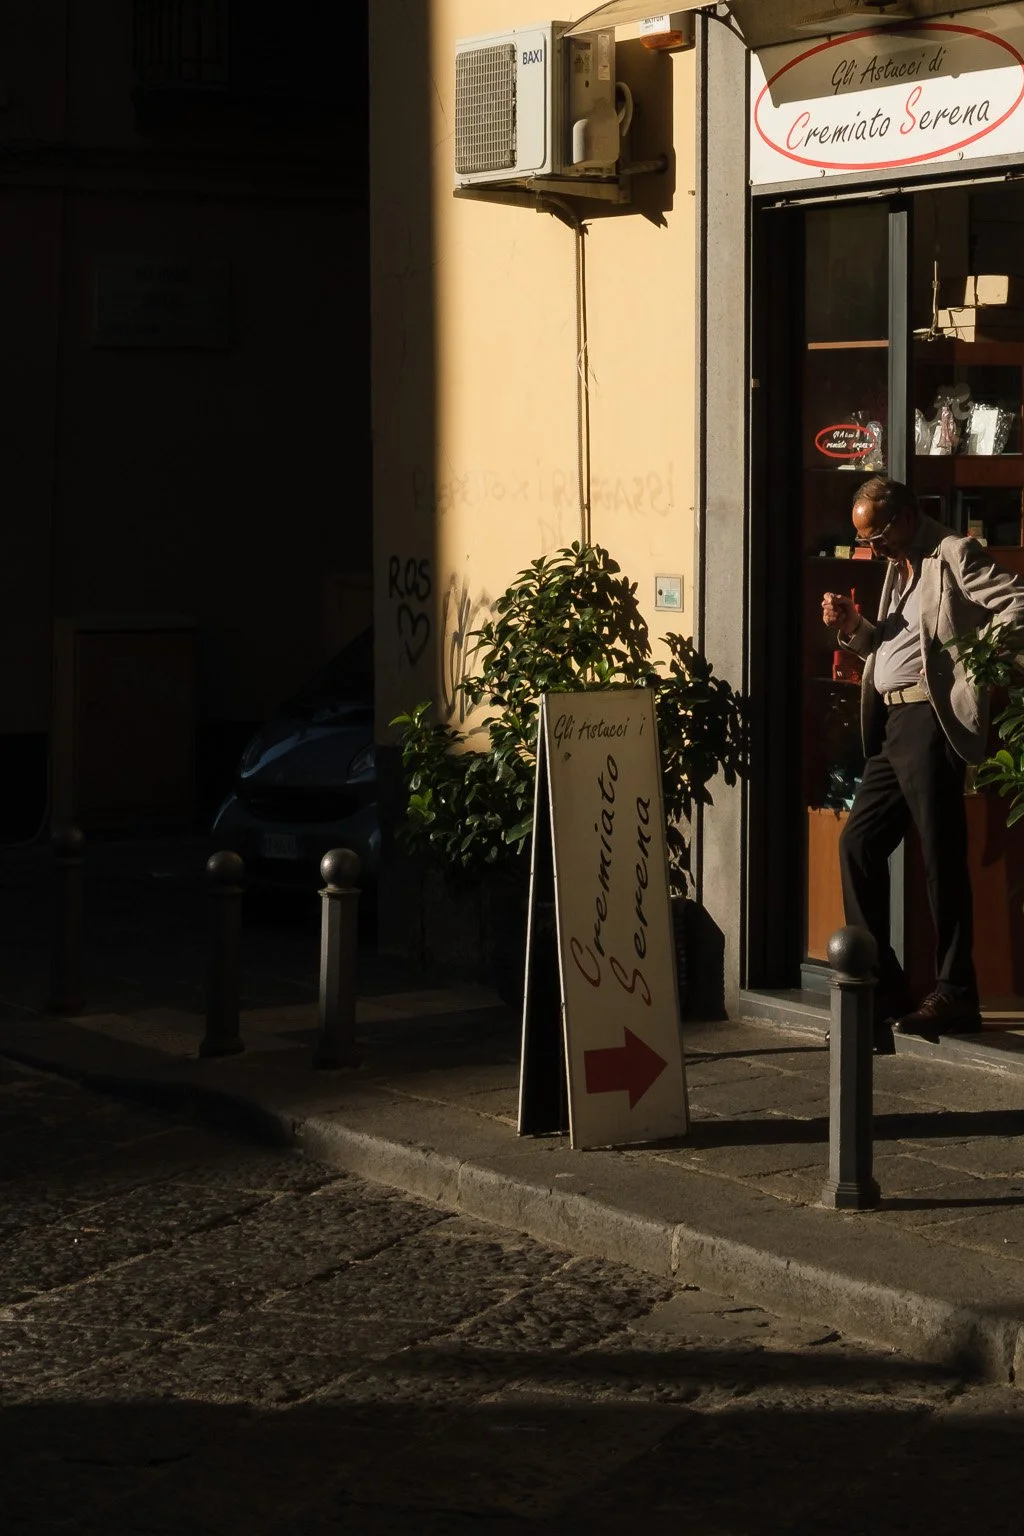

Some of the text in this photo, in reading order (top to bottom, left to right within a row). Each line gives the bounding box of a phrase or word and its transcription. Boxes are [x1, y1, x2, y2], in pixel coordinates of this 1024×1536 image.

[522, 48, 542, 65] BAXI
[831, 47, 946, 94] Gli Astucci di
[786, 86, 990, 150] Cremiato Serena
[553, 714, 576, 749] Gli
[570, 753, 619, 989] Cremiato
[611, 796, 652, 1007] Serena
